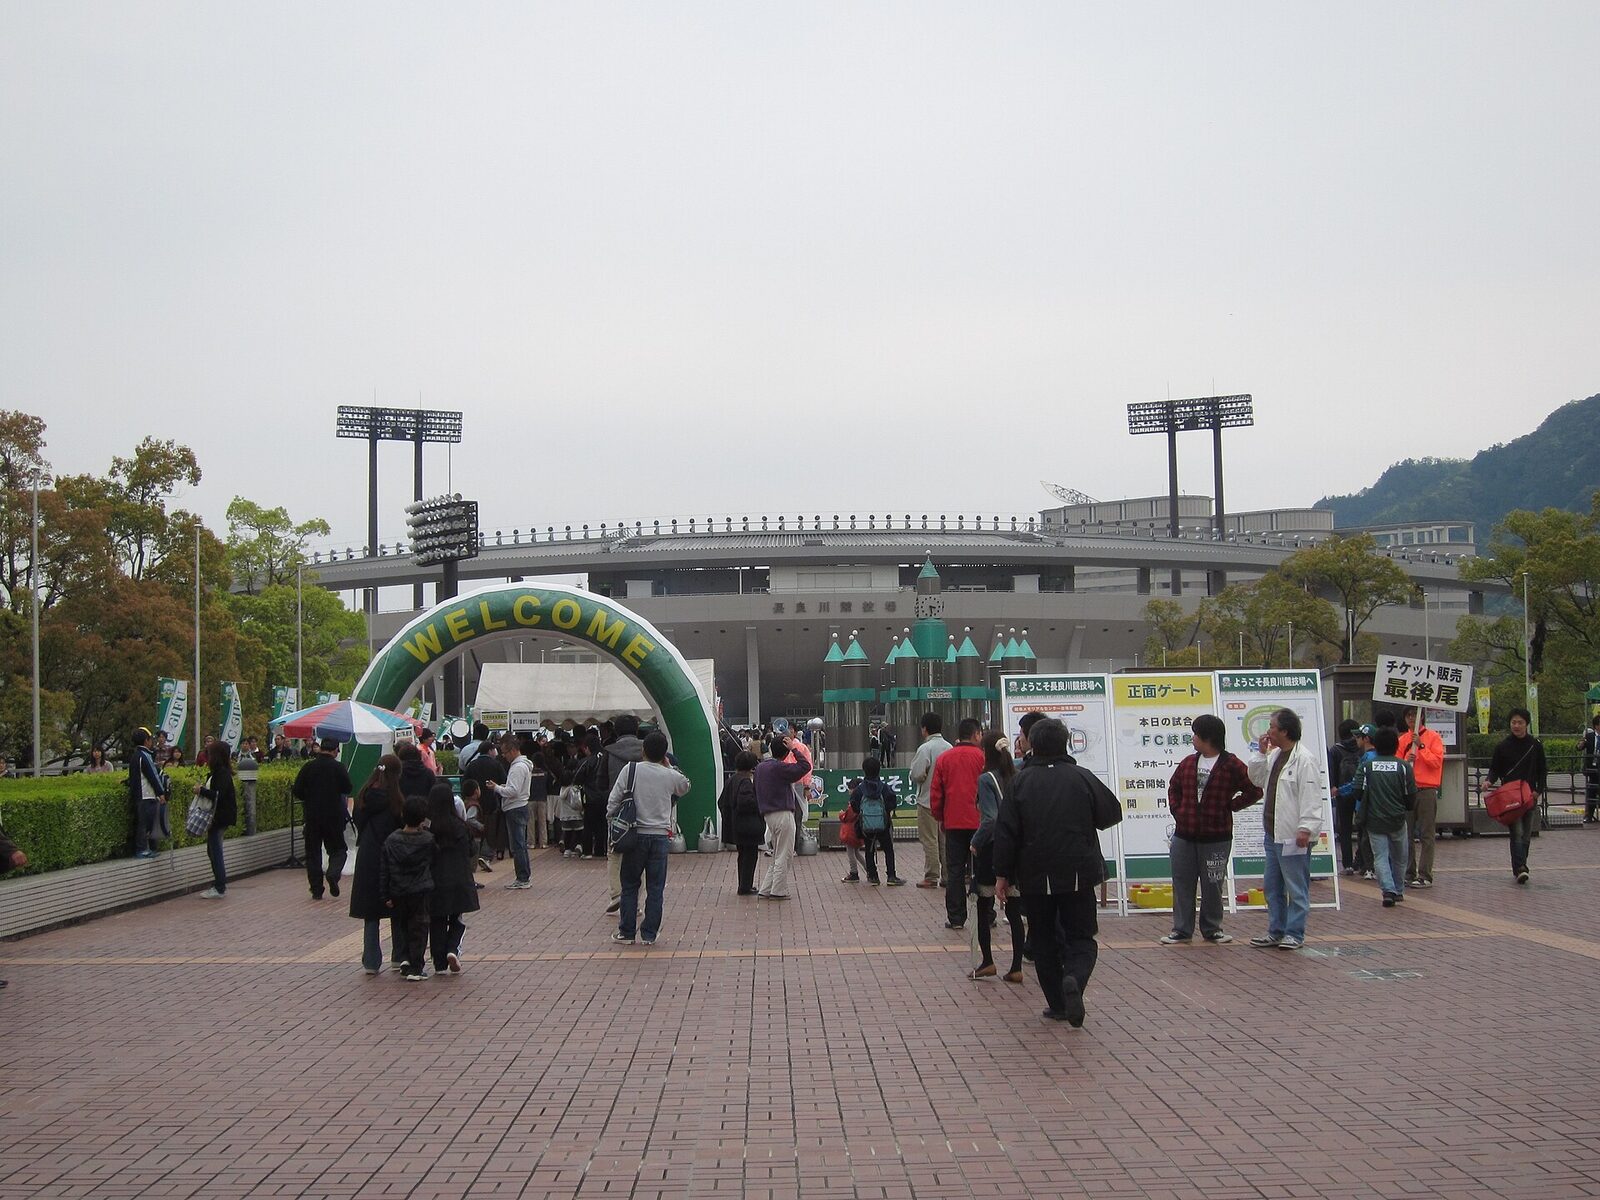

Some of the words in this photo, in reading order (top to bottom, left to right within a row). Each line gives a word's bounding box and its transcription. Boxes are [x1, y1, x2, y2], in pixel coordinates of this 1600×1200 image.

[402, 595, 655, 669] WELCOME
[1386, 660, 1463, 683] チケット販売
[1020, 681, 1103, 692] ようこそ長良川競技場へ
[1232, 676, 1315, 688] ようこそ長良川競技場へ
[1127, 683, 1201, 699] 正面ゲート
[1384, 677, 1460, 706] 最後尾
[168, 690, 187, 729] GIFU
[1139, 716, 1193, 728] 本日の試合
[1125, 778, 1166, 790] 試合開始
